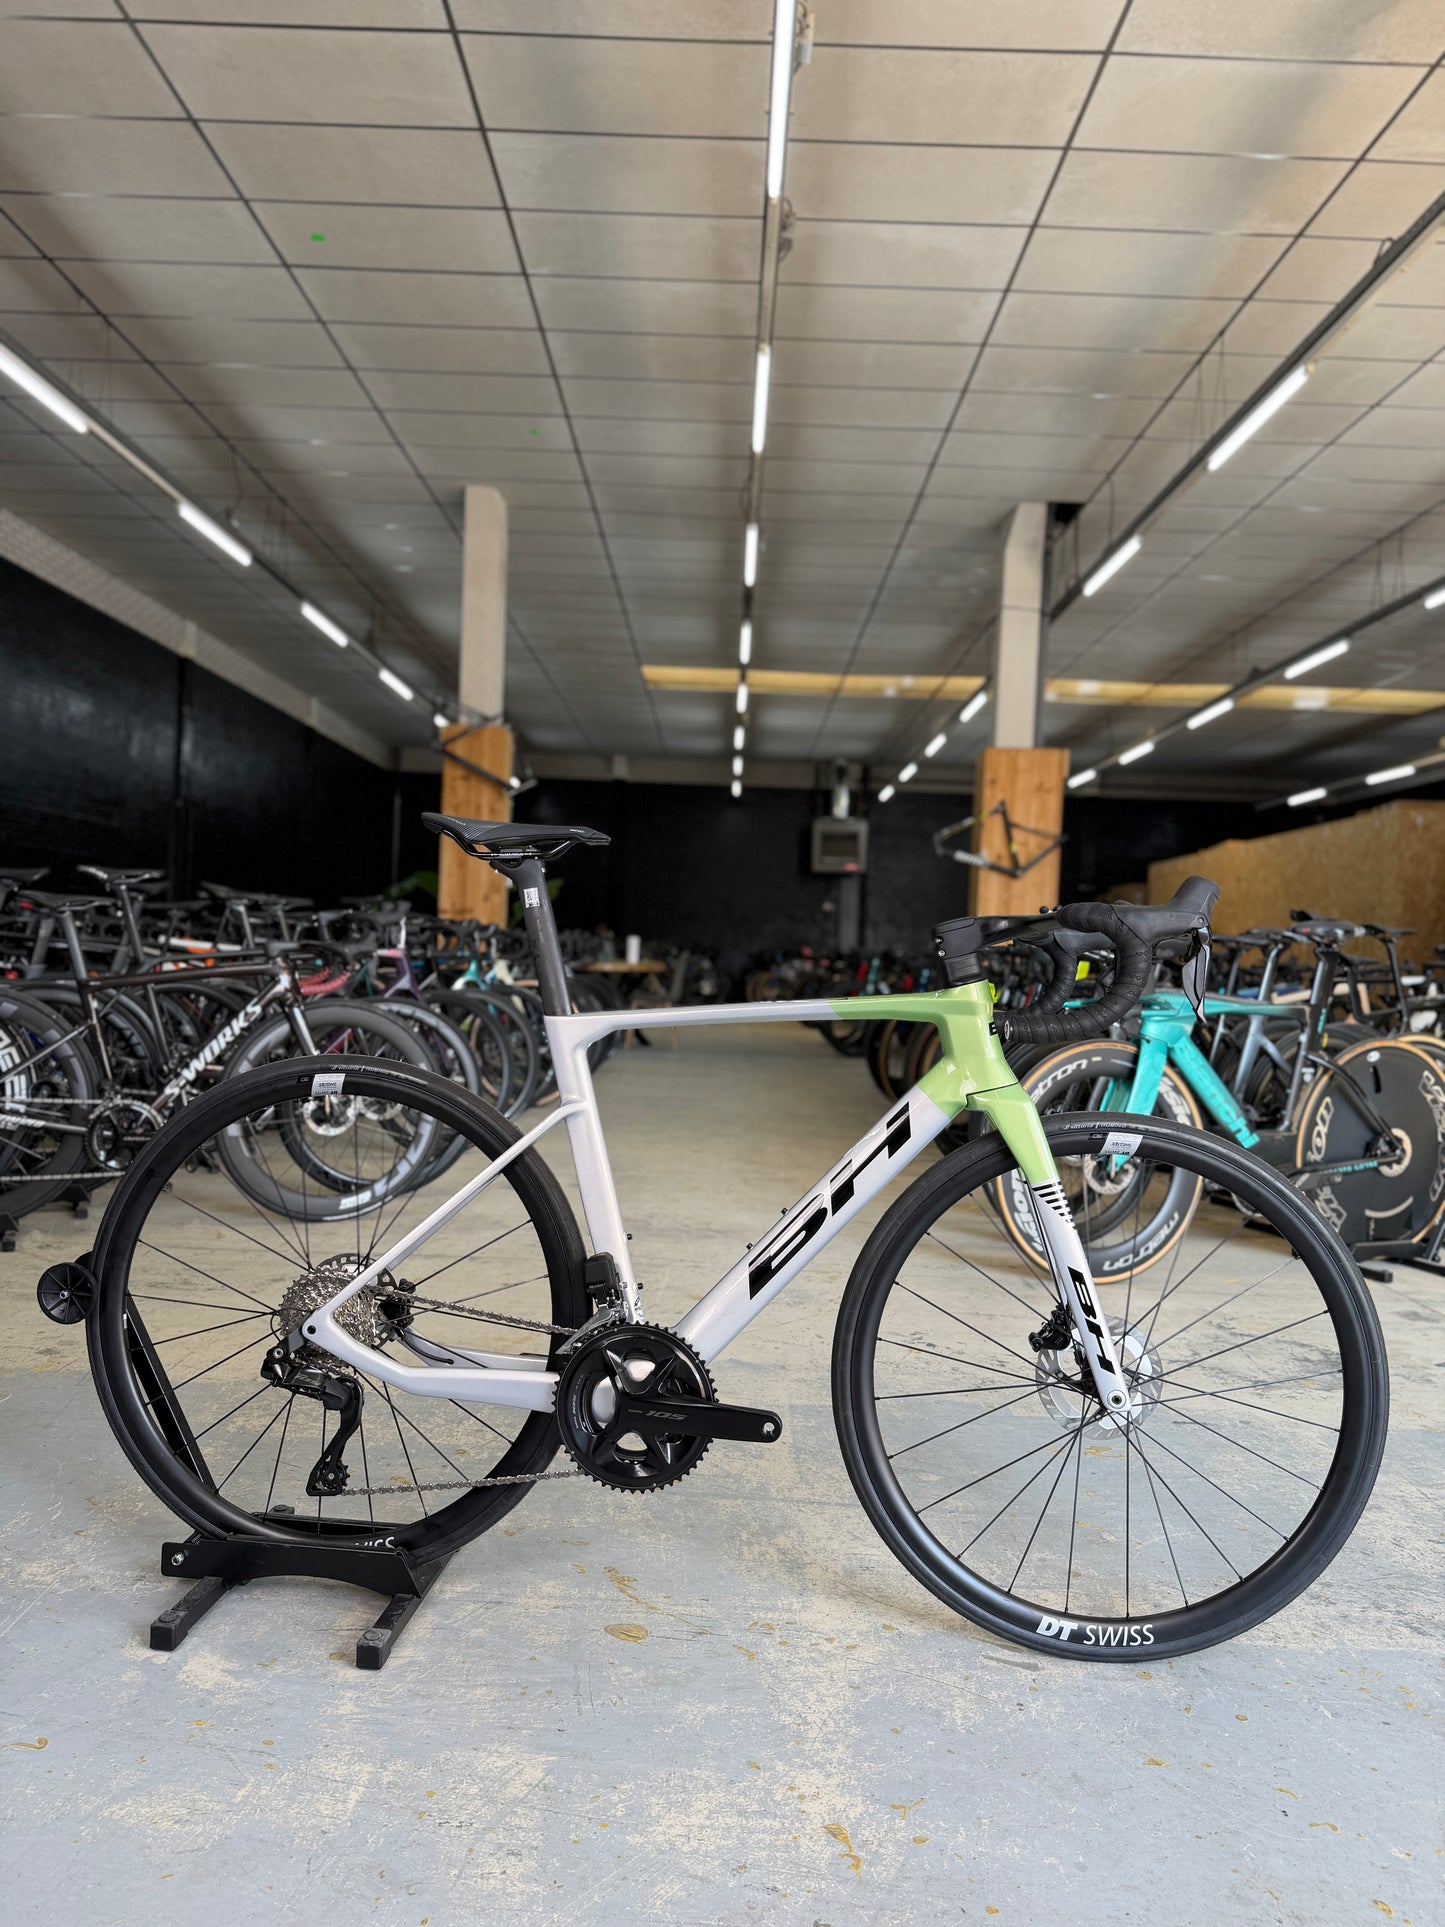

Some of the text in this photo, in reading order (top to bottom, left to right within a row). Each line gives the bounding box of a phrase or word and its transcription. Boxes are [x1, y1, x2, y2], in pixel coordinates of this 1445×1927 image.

[164, 997, 262, 1101] S-WORKS
[1031, 1058, 1088, 1105] etron
[1173, 1035, 1261, 1149] Bianchi
[748, 1101, 911, 1300] BH
[1102, 1211, 1179, 1271] metron
[1067, 1266, 1116, 1375] BH
[646, 1410, 688, 1420] 105
[1036, 1615, 1154, 1646] DT SWISS
